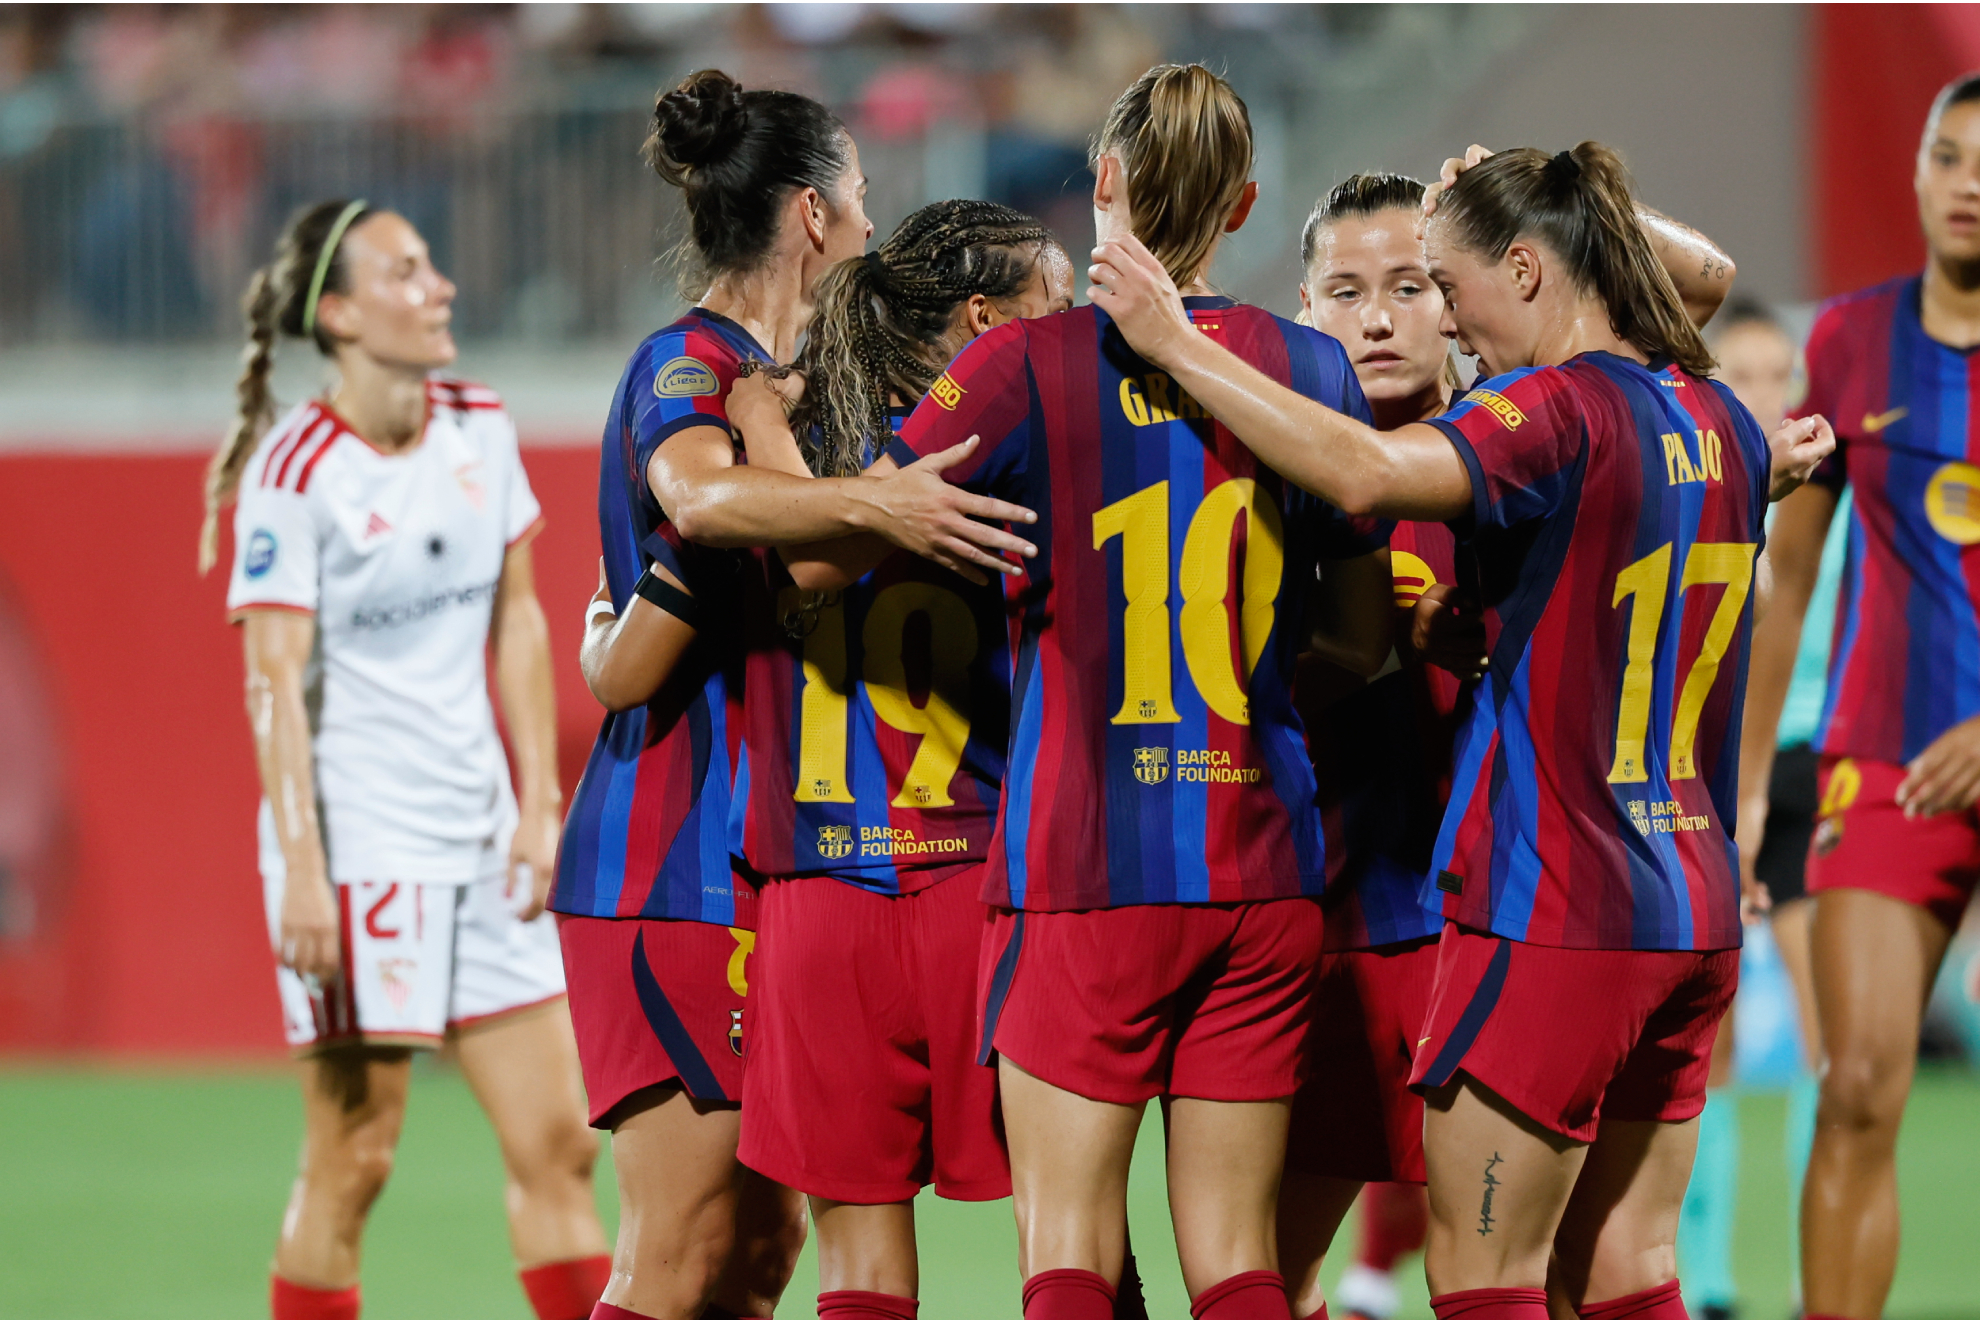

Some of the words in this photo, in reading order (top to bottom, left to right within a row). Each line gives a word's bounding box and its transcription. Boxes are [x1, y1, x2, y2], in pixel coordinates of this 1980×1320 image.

[1119, 372, 1214, 427] GRA
[1660, 429, 1723, 486] PAJO
[1092, 477, 1284, 726] 10
[1606, 541, 1758, 784] 17
[777, 581, 978, 808] 19
[1177, 750, 1231, 767] BARÇA
[860, 826, 915, 842] BARÇA
[1650, 801, 1683, 817] BARÇ
[861, 838, 968, 857] FOUNDATION
